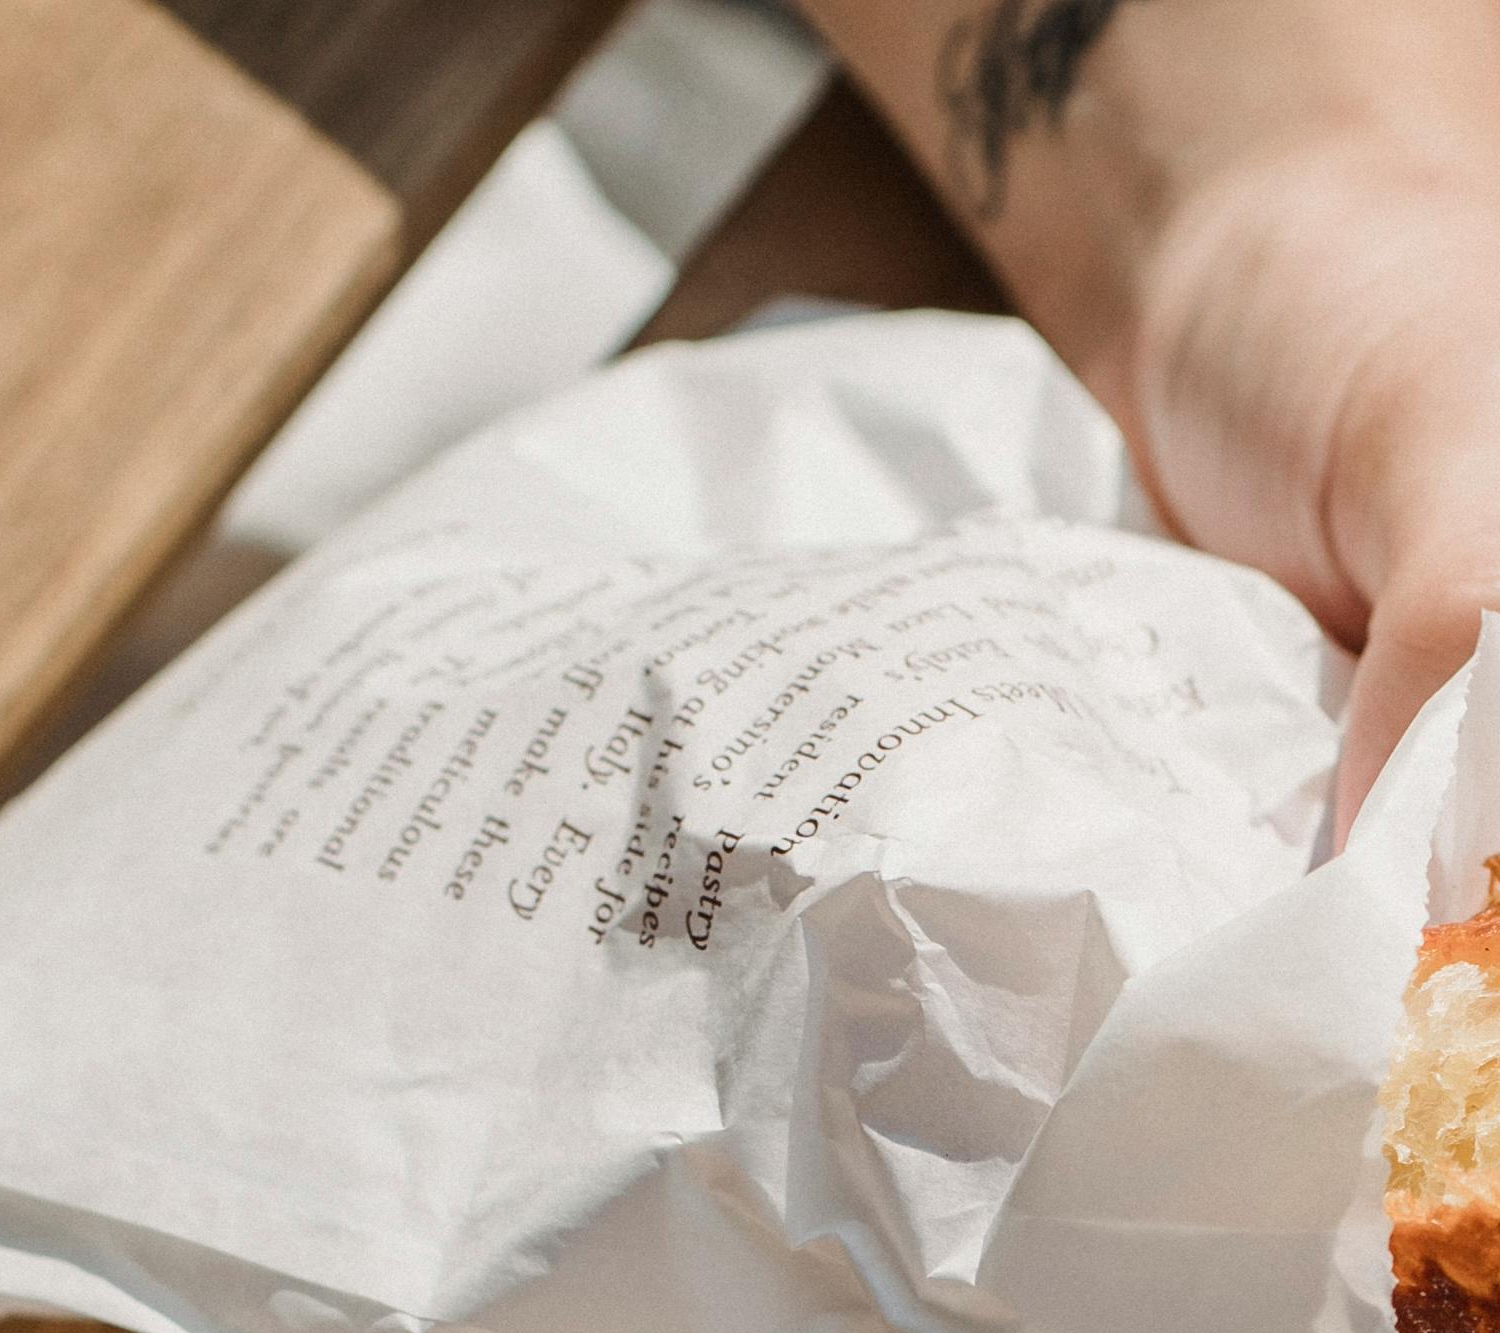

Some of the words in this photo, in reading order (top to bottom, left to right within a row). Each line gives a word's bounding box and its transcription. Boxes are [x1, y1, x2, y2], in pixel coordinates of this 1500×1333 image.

[695, 614, 830, 696] working
[503, 706, 569, 798] make
[581, 707, 654, 790] Italy.
[672, 697, 706, 728] at
[693, 637, 883, 791] Montersino's
[753, 693, 864, 801] resident
[315, 701, 446, 873] traditional
[377, 706, 499, 882] meticulous
[647, 738, 684, 789] his
[771, 698, 985, 856] Innovation
[443, 814, 512, 901] these
[507, 816, 595, 921] Every
[615, 802, 652, 876] side
[638, 815, 685, 949] recipes
[587, 877, 627, 945] for
[685, 827, 746, 951] Pastry
